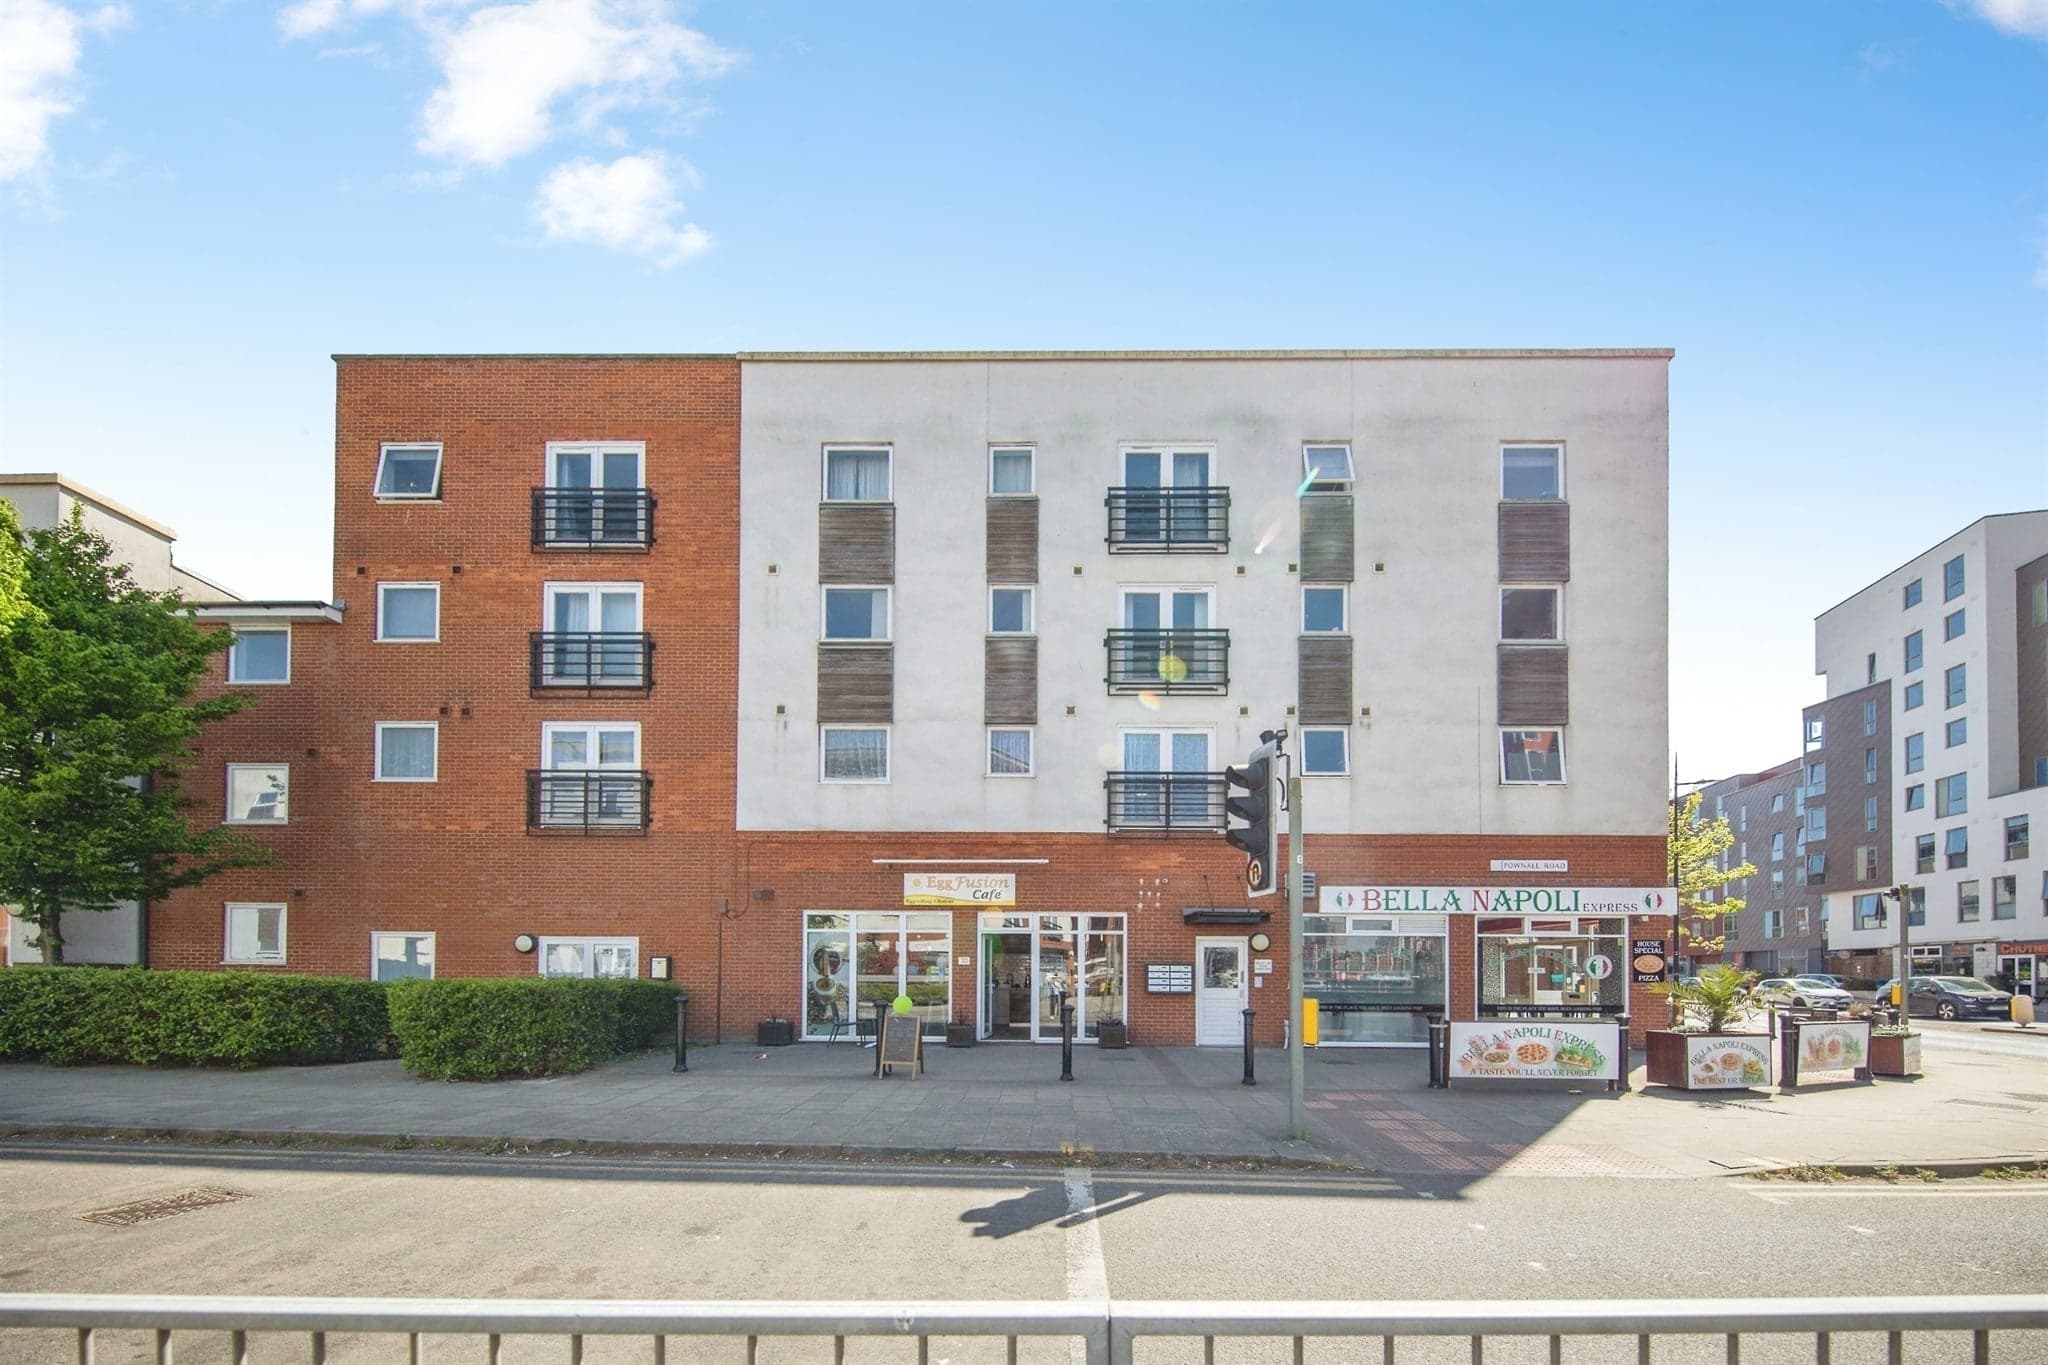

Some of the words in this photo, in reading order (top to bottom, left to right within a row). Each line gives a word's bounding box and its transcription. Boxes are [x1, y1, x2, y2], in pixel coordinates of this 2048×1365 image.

[1544, 862, 1566, 870] ROAD
[926, 875, 952, 891] Egg
[952, 875, 1010, 891] Fusion
[1362, 889, 1463, 911] BELLA
[1473, 889, 1580, 912] NAPOLI
[1583, 903, 1638, 912] EXPRESS
[1637, 940, 1660, 948] HOUSE
[1462, 1034, 1503, 1062] BELLA
[1503, 1027, 1551, 1041] NAPOLI
[1554, 1029, 1607, 1062] EXPRESS
[1690, 1046, 1712, 1066] BELLA
[1712, 1040, 1739, 1051] NAPOLI
[1740, 1041, 1769, 1065] EXPRESS
[1470, 1068, 1476, 1076] A
[1479, 1068, 1505, 1076] TASTE
[1507, 1068, 1535, 1076] YOU'LL
[1537, 1068, 1564, 1076] NEVER
[1566, 1068, 1598, 1077] FORGET
[1709, 1077, 1726, 1085] BEST
